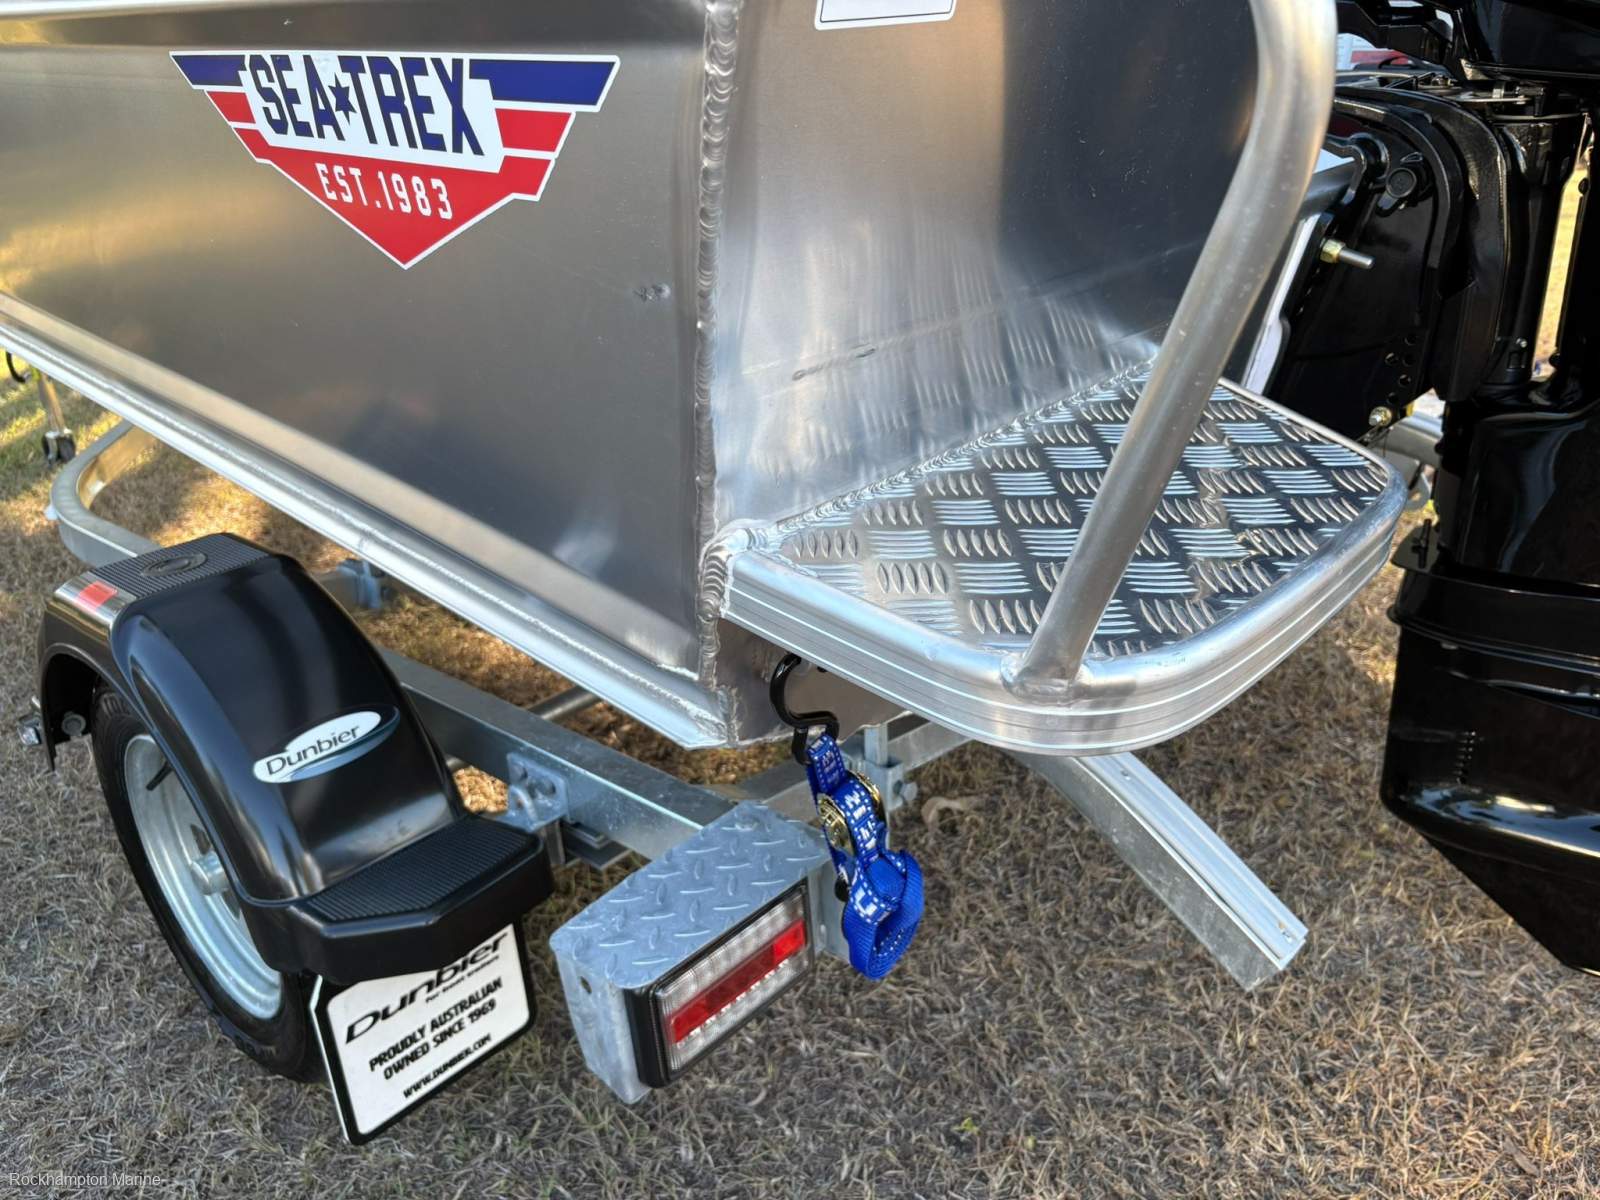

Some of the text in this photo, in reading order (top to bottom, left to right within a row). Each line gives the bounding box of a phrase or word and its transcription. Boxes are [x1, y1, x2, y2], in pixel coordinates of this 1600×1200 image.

[248, 54, 485, 155] SEA TREX
[266, 725, 360, 775] Dunbier
[345, 932, 508, 1044] Dunbier
[369, 1024, 426, 1072] PROUDLY
[430, 977, 503, 1032] AUSTRALIAN
[383, 998, 496, 1080] OWNED SINCE 1969
